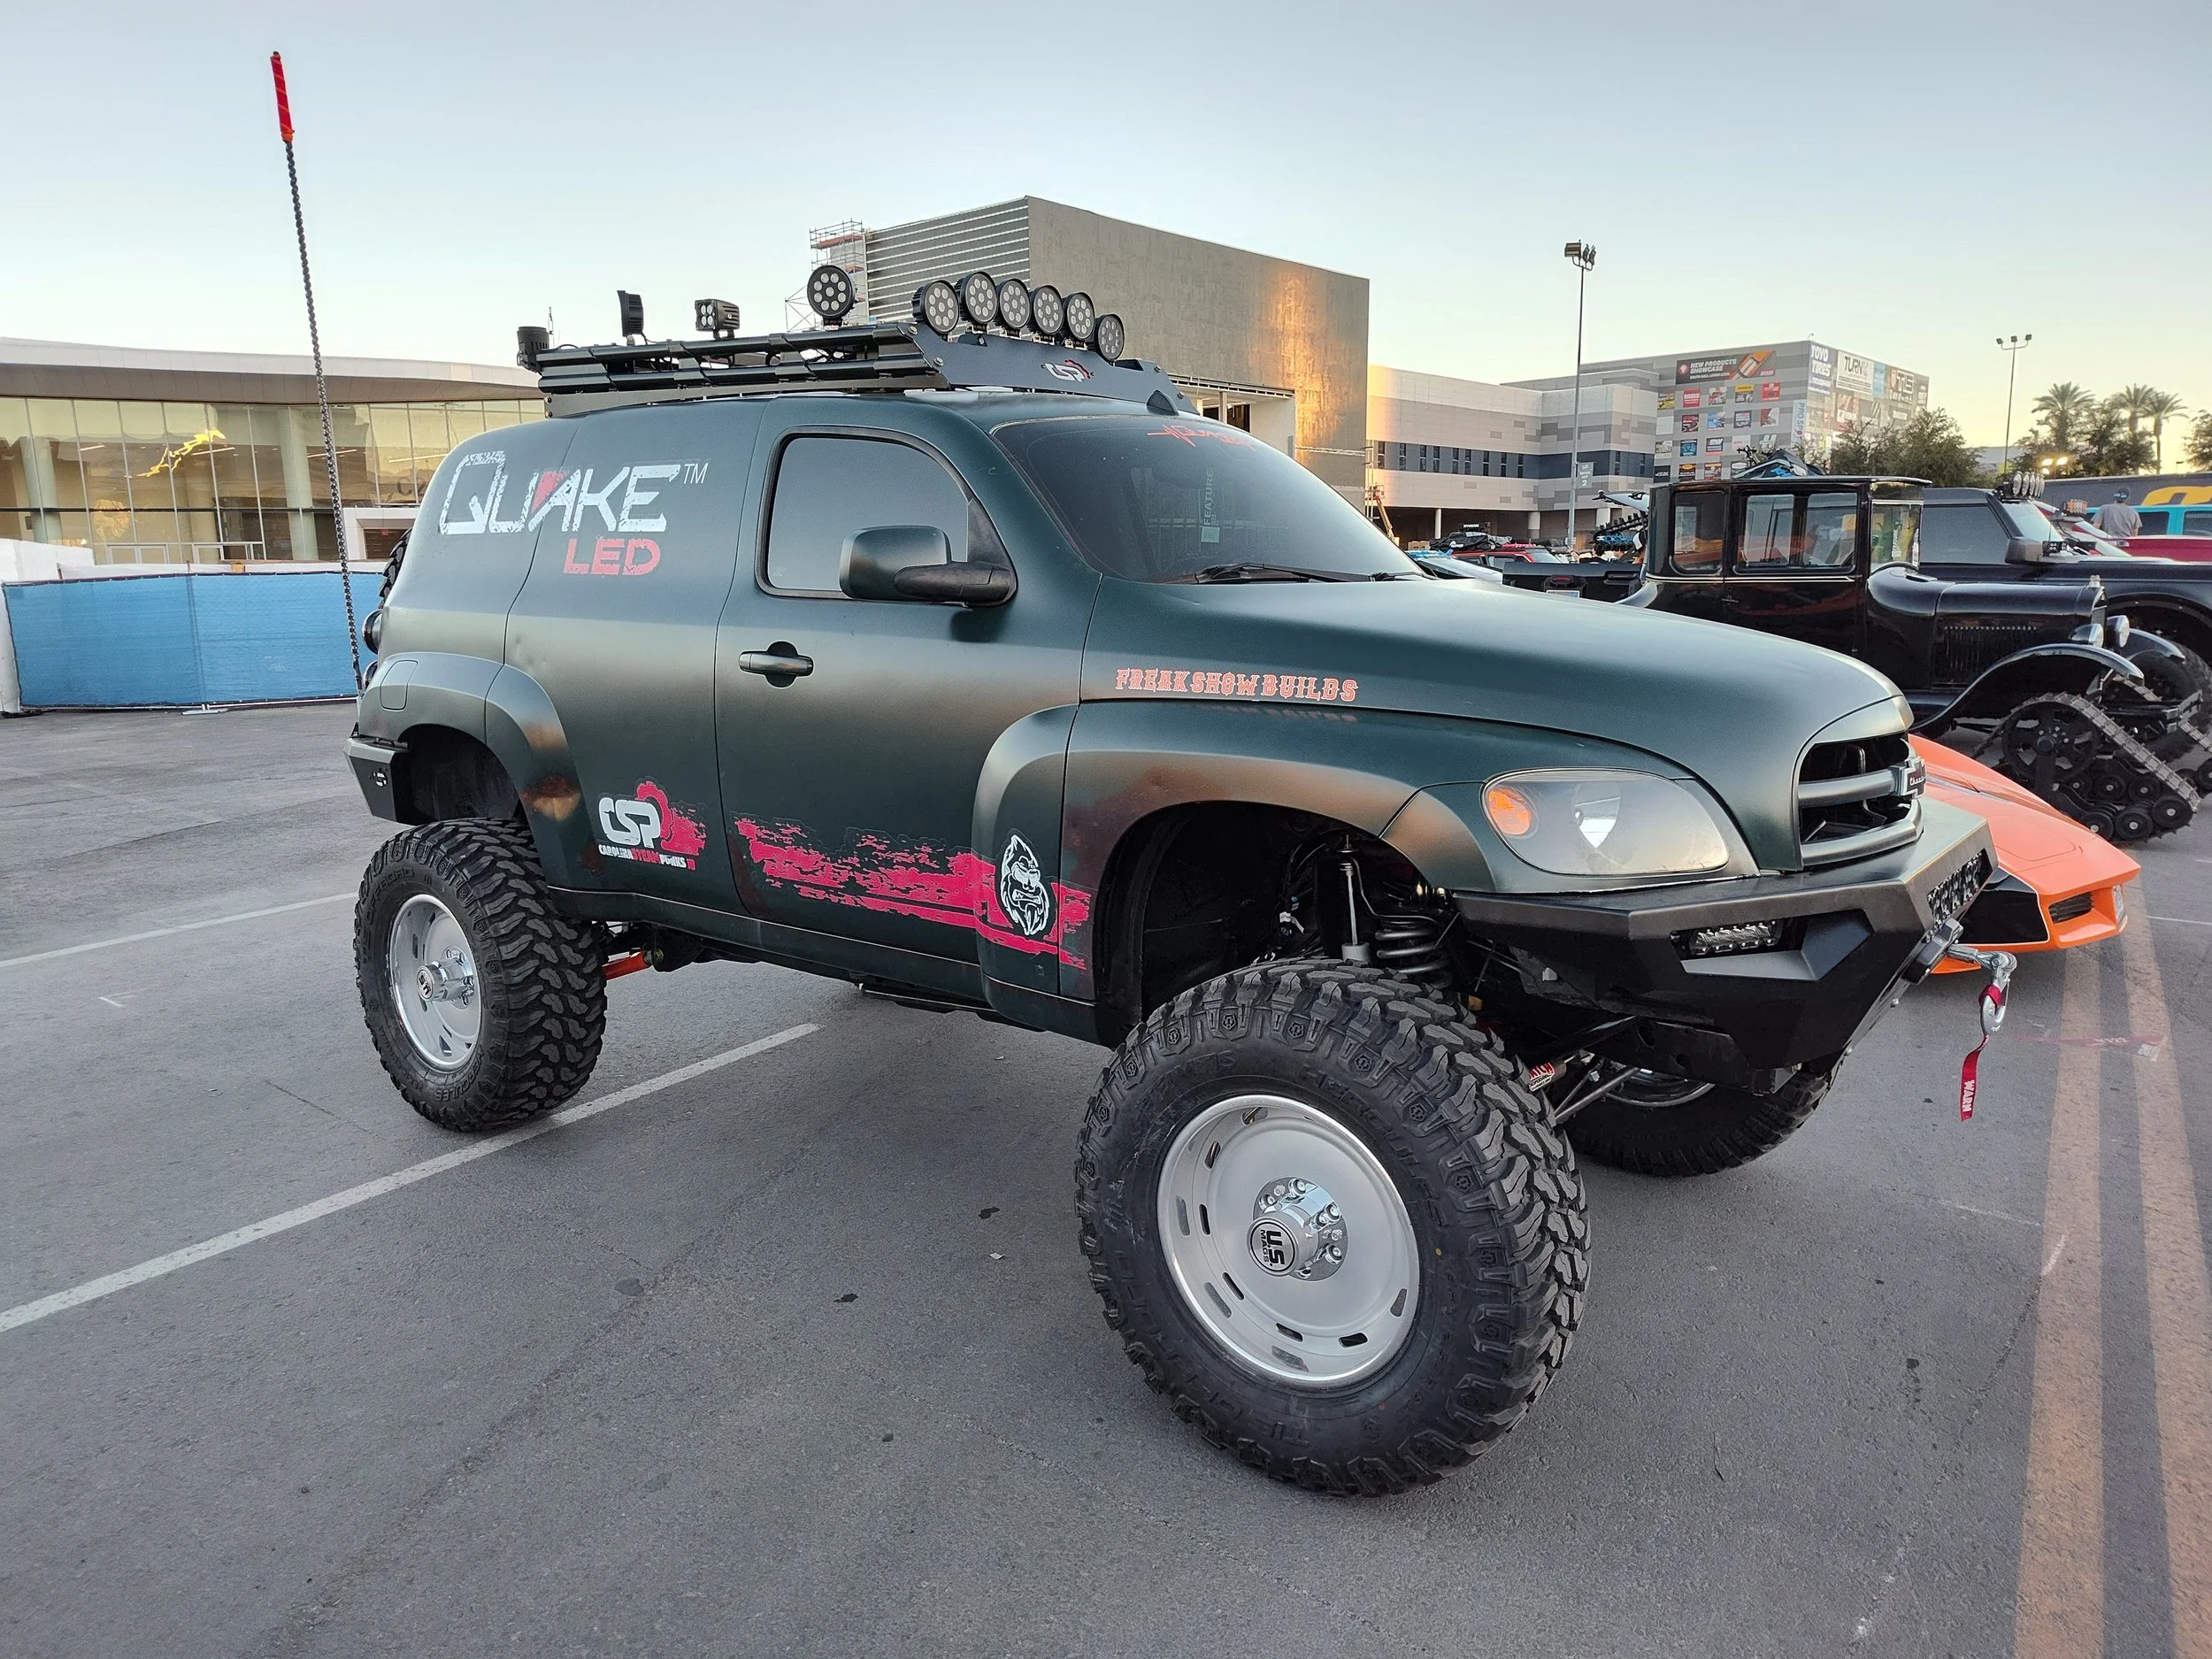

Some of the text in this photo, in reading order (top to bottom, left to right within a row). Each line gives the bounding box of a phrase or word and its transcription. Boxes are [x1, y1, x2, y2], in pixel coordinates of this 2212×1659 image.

[1690, 365, 1723, 374] SHOWCASE
[1704, 358, 1737, 367] PRODUCTS
[1811, 345, 1829, 362] TOYO
[1812, 360, 1832, 377] TIRES
[440, 450, 680, 534] QUAKE
[564, 538, 661, 575] LED
[1115, 668, 1359, 702] FREAK SHOW BUILDS
[599, 797, 661, 849] CSP
[1962, 1079, 1975, 1112] WARN
